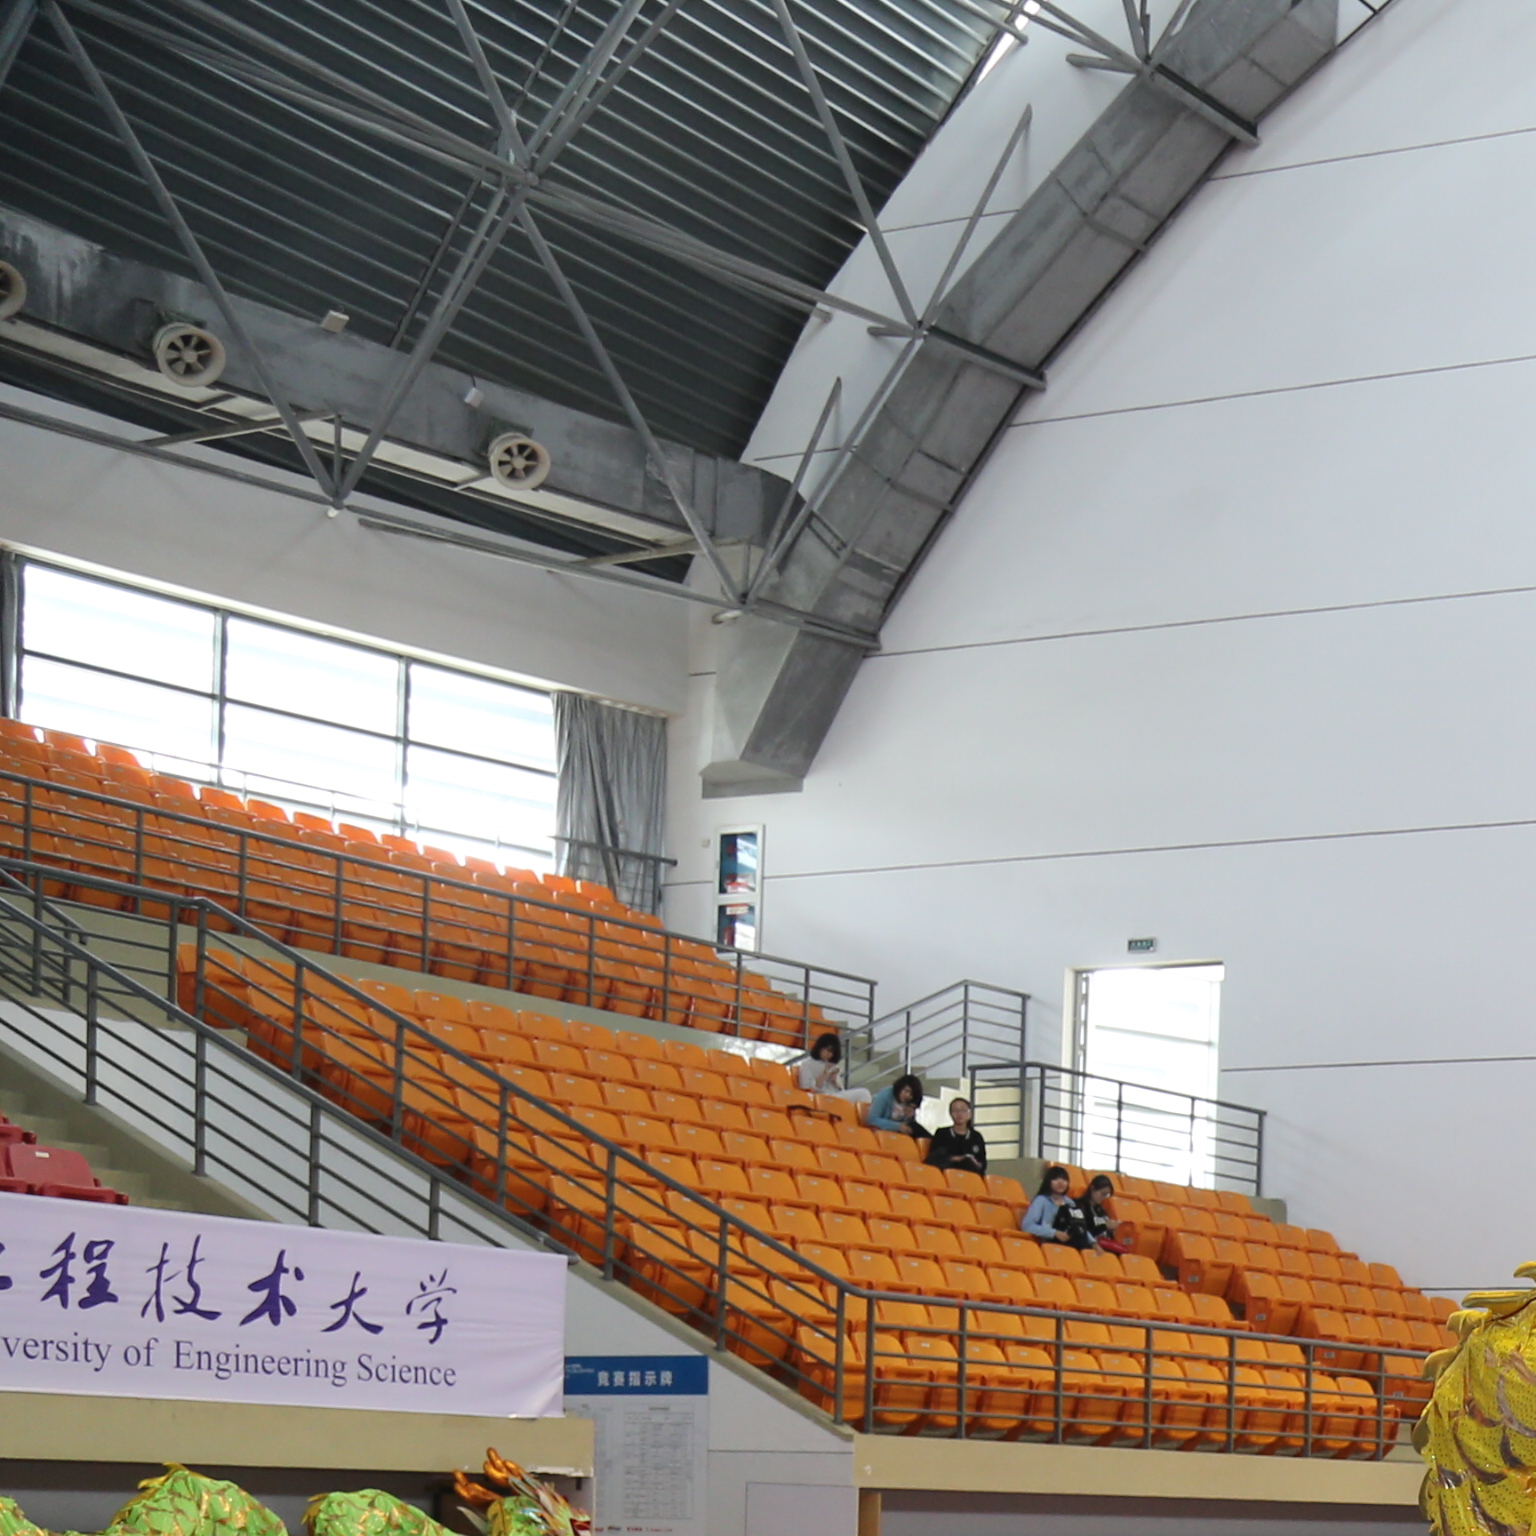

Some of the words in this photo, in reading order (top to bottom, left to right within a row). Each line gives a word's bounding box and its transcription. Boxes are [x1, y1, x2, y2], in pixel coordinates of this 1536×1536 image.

[0, 1231, 457, 1345] 程技术大学
[123, 1337, 159, 1367] of
[173, 1340, 347, 1387] Engineering
[357, 1353, 456, 1387] Science
